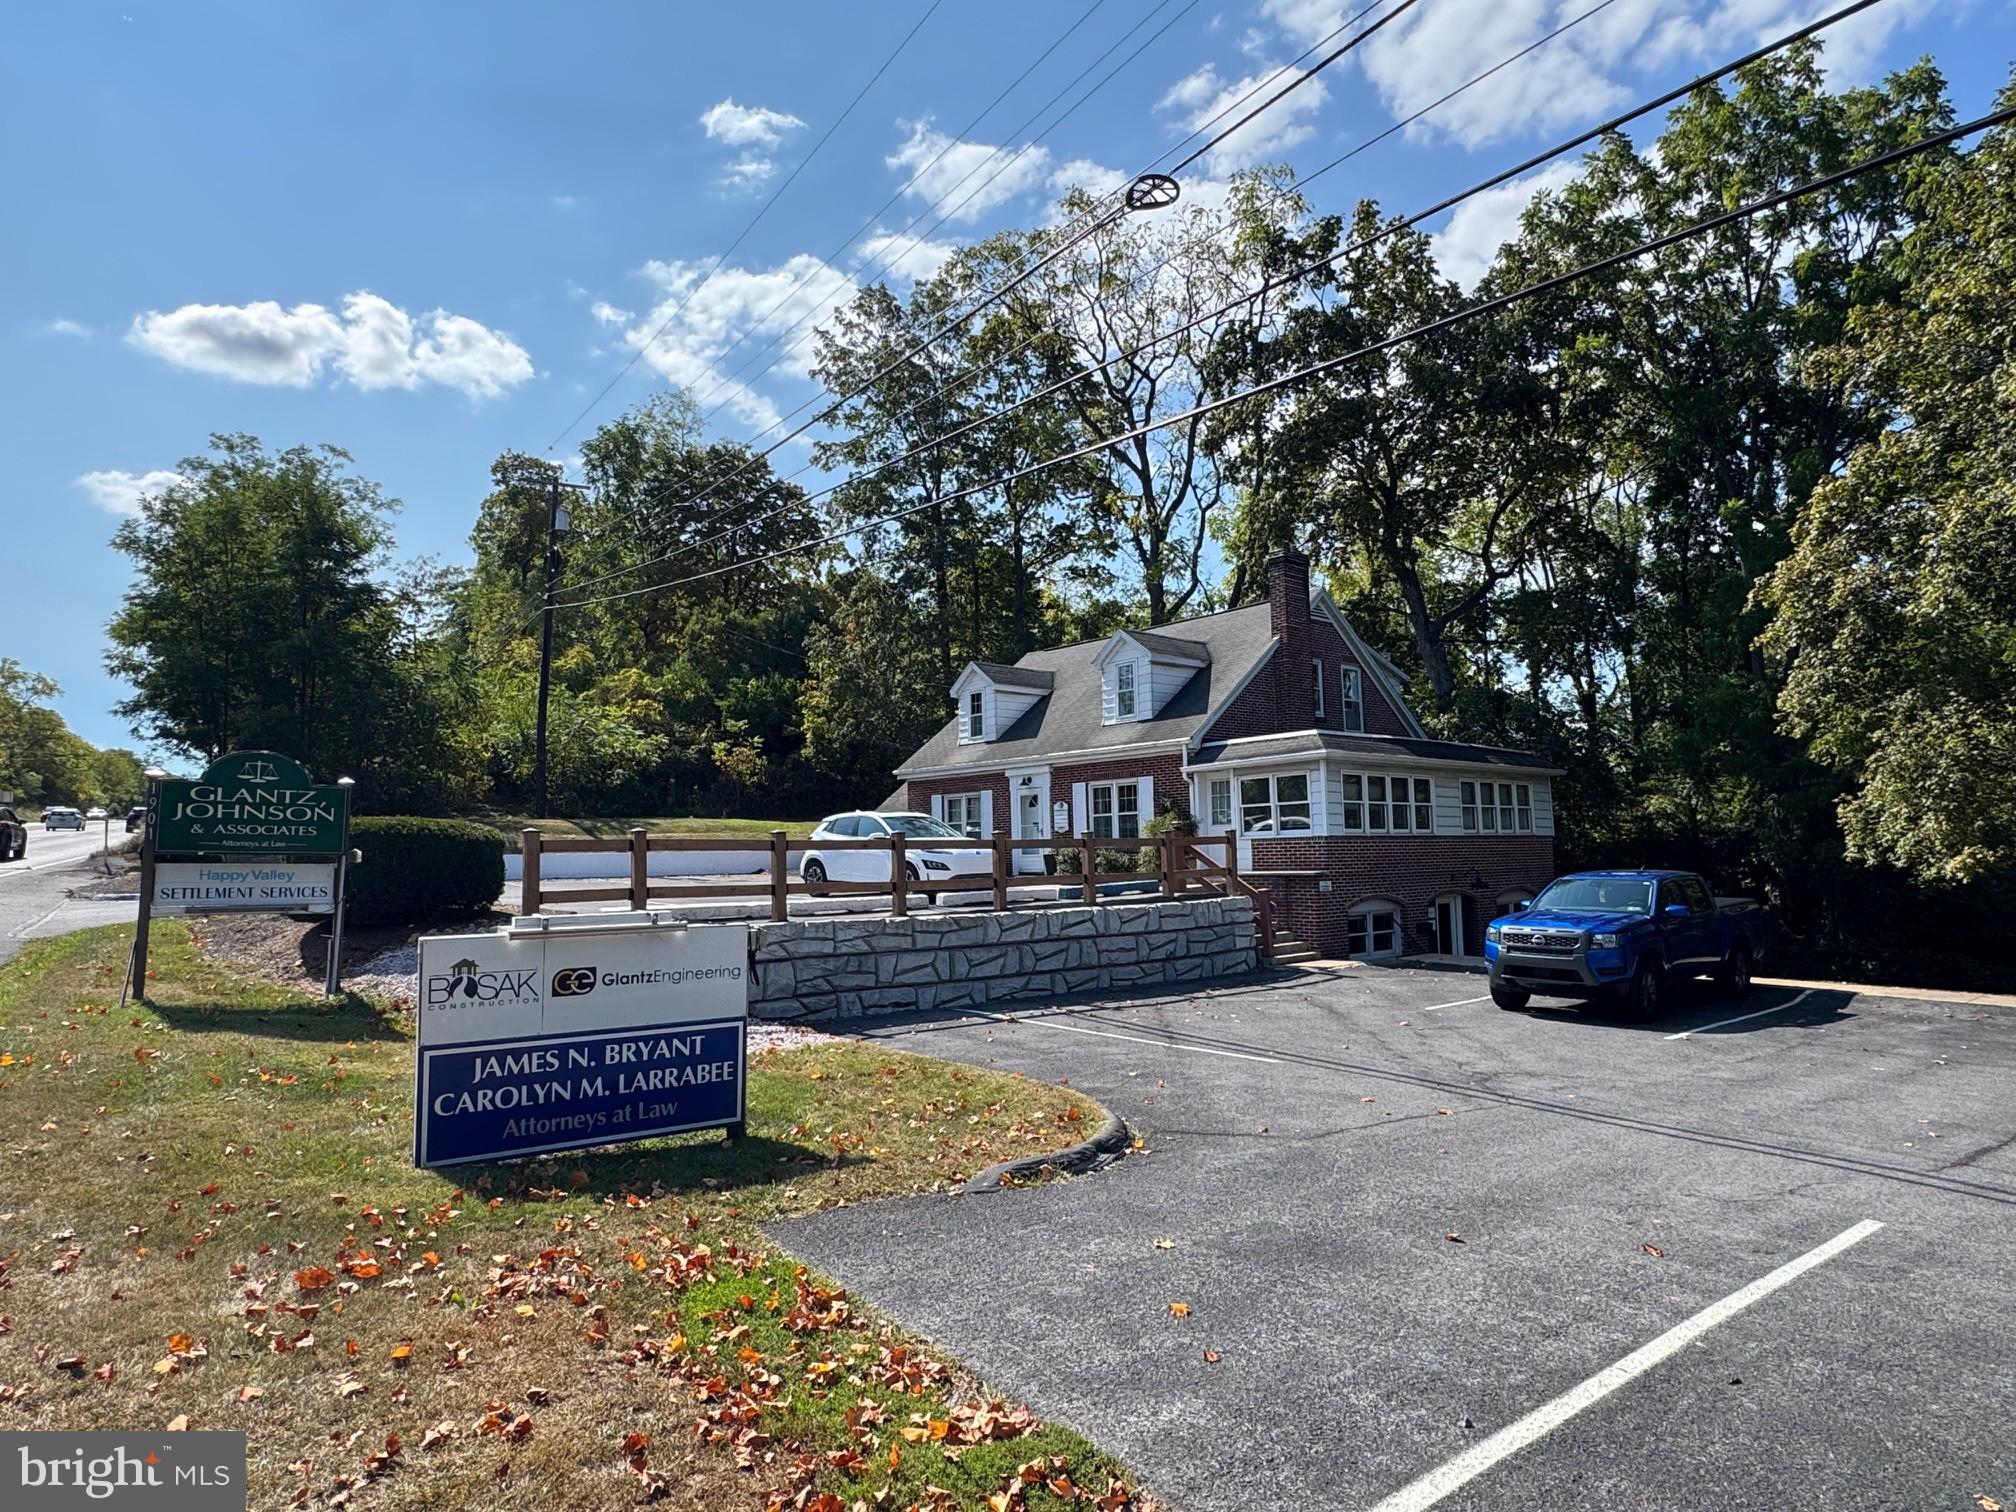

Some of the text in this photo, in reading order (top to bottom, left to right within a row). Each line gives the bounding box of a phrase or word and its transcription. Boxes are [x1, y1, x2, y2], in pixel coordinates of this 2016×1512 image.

[171, 803, 335, 822] JOHNSON
[190, 823, 317, 836] & ASSOCIATES
[221, 840, 260, 848] Attorneys
[199, 869, 295, 883] Happy Valley
[160, 886, 328, 900] SETTLEMENT SERVICES
[601, 966, 742, 987] GlantzEngineering
[428, 997, 540, 1012] CONSTRUCTION
[472, 1035, 706, 1084] JAMES N. BRYANT
[433, 1061, 735, 1117] CAROLYN M. LARRABEE
[502, 1101, 679, 1139] Attorneys at Law
